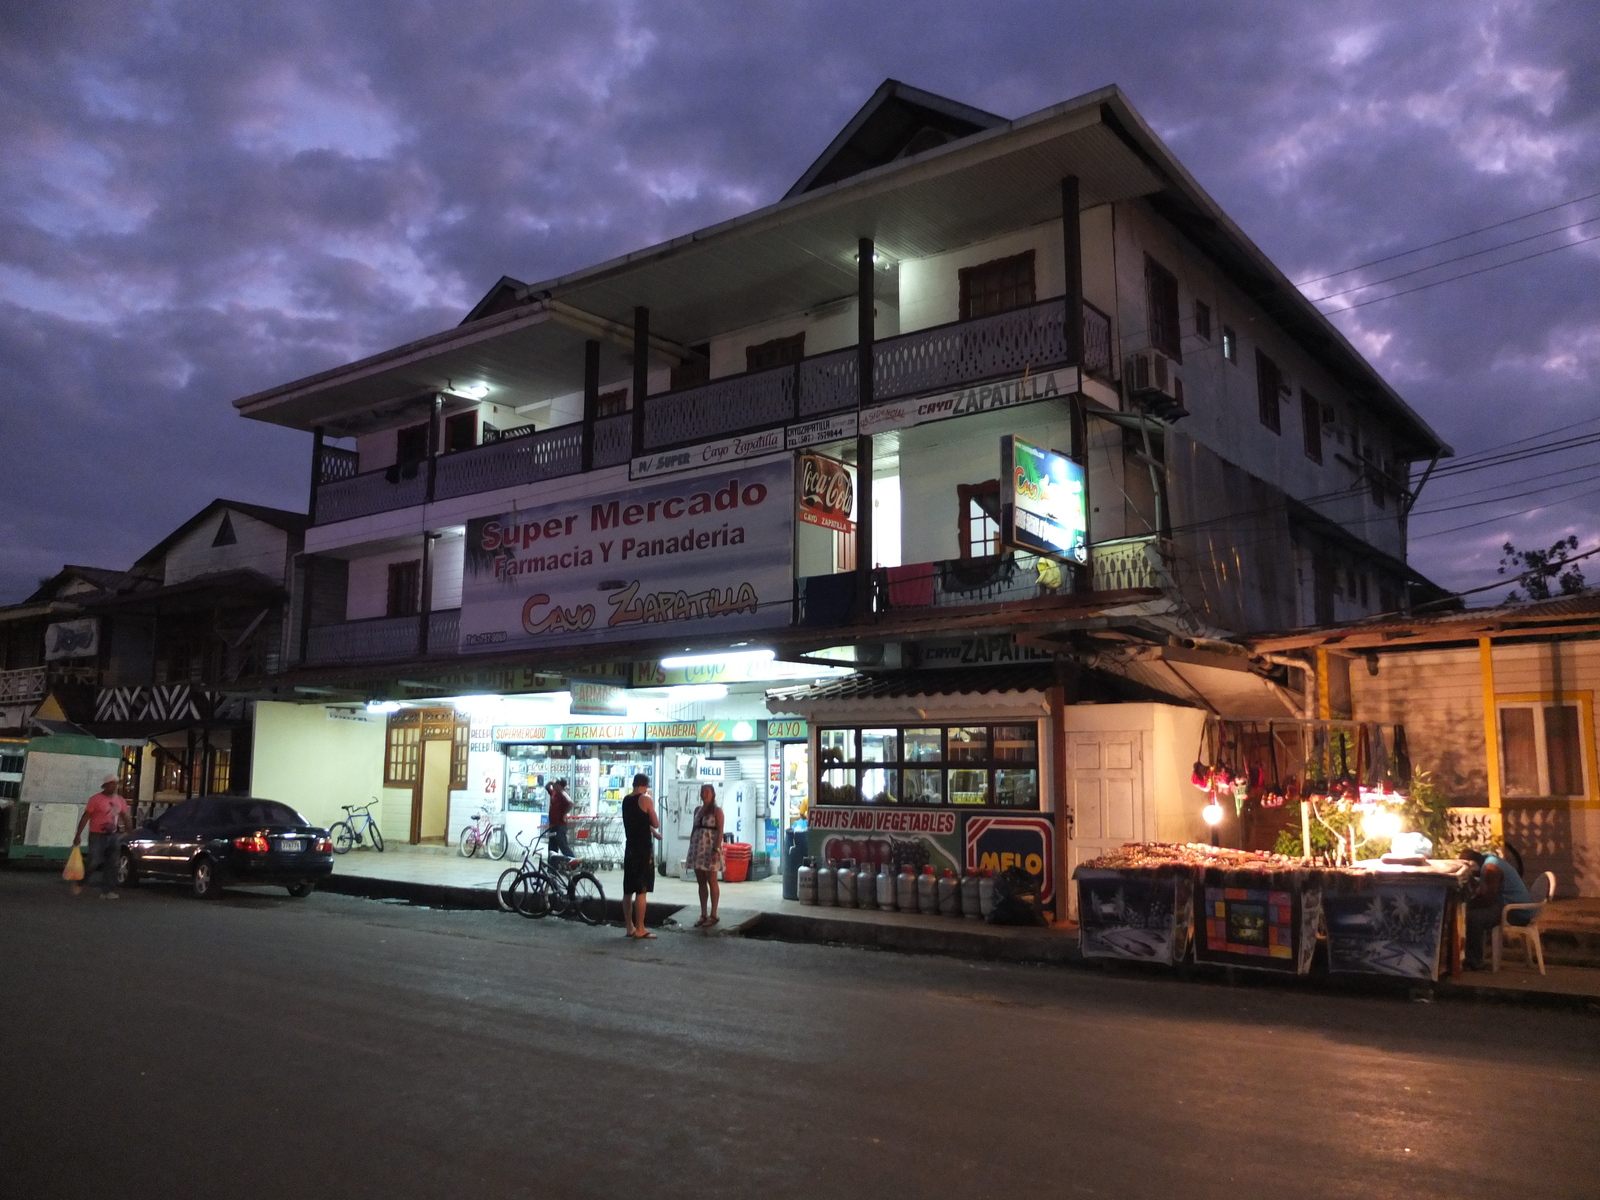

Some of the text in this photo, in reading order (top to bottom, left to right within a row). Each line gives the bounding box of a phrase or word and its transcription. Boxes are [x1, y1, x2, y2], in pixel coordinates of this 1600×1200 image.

[918, 374, 1058, 415] CAYO ZAPATILLA
[655, 452, 691, 470] SUPER
[702, 445, 729, 462] Cayo
[732, 433, 778, 456] Zapatilla
[481, 479, 767, 550] Super Mercado
[803, 512, 847, 531] CAYO ZAPATILLA
[494, 545, 593, 578] Farmacia
[599, 540, 615, 563] Y
[925, 646, 961, 660] CAYO
[495, 726, 546, 740] SUPERMERCADO
[567, 724, 625, 739] FARMACIA
[646, 723, 697, 738] PANADERIA
[768, 721, 801, 737] CAYO
[485, 777, 496, 793] 24
[808, 809, 955, 833] FRUITS AND VEGETABLES
